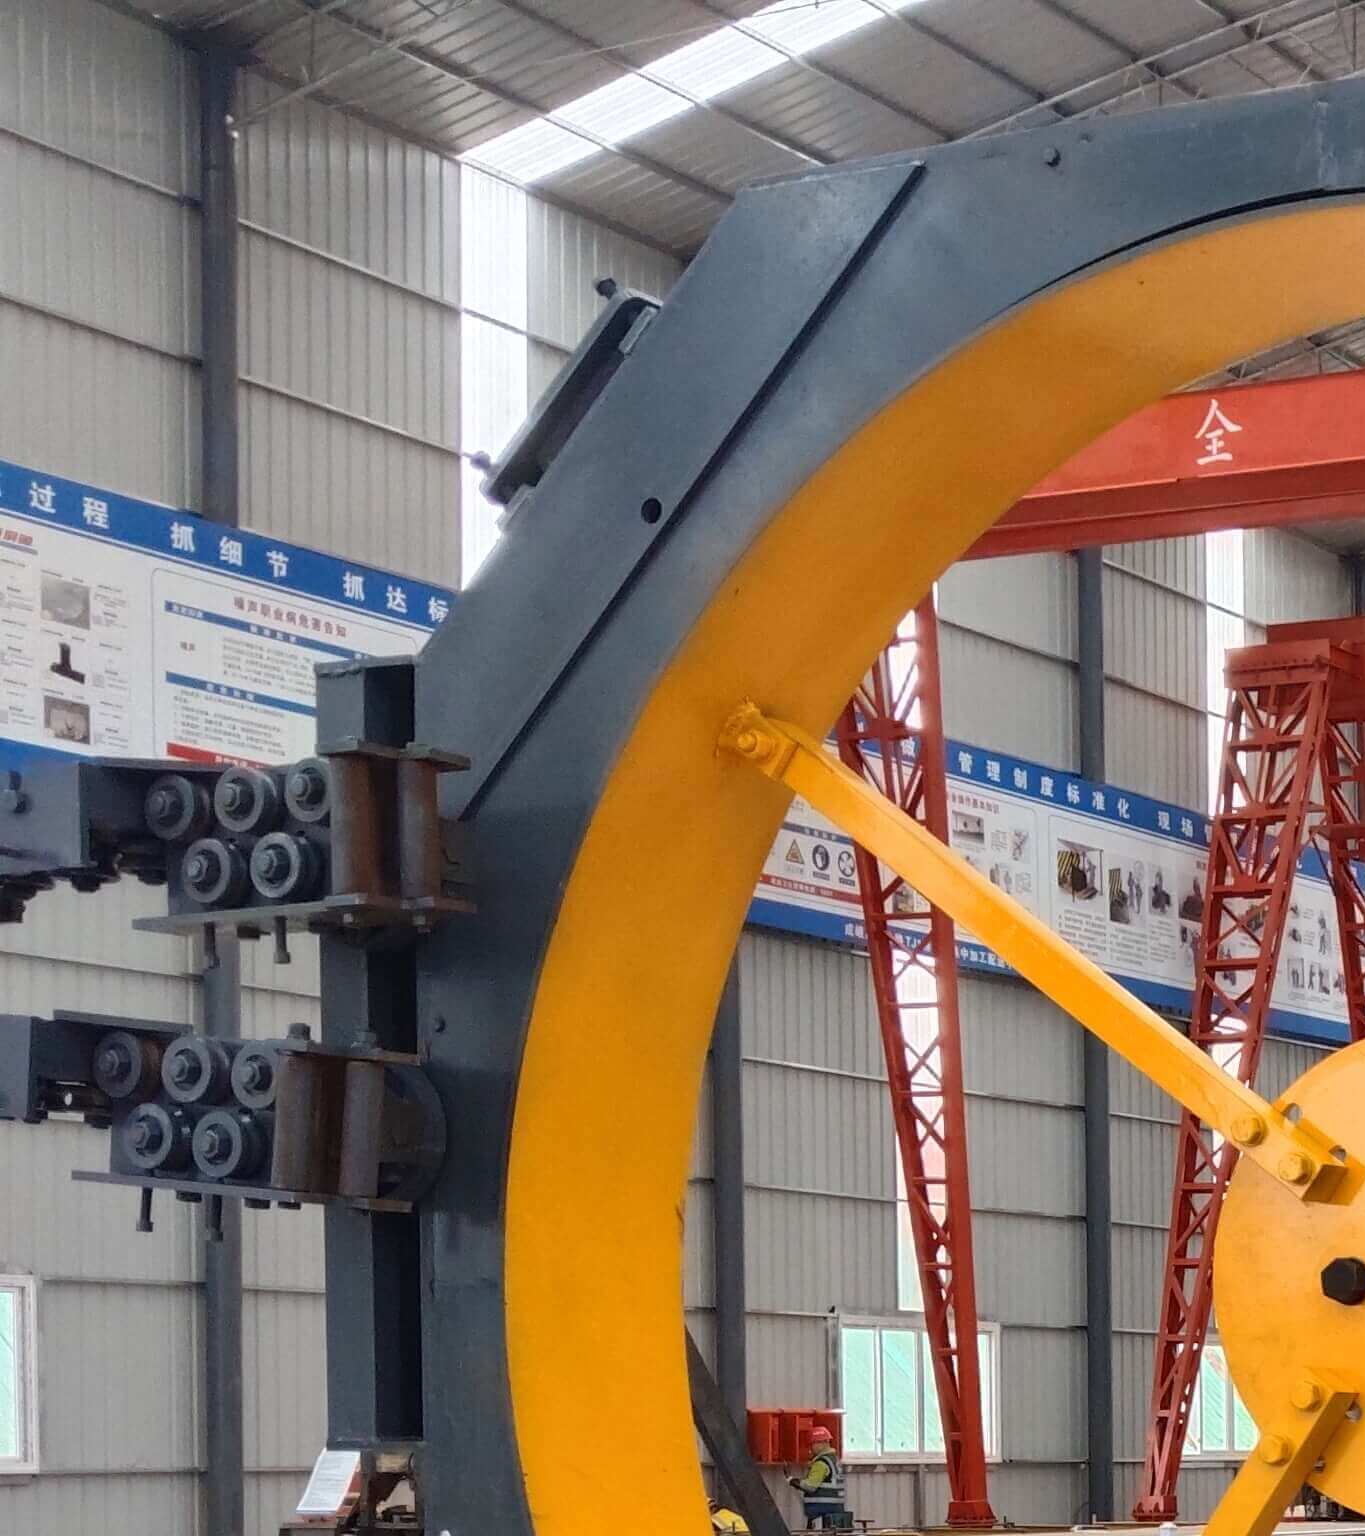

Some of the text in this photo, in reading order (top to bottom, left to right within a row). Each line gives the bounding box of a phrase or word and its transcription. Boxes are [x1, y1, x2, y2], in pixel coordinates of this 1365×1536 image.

[170, 522, 289, 578] 抓细节
[343, 572, 449, 623] 抓达标
[957, 750, 1131, 820] 管理制度标准化
